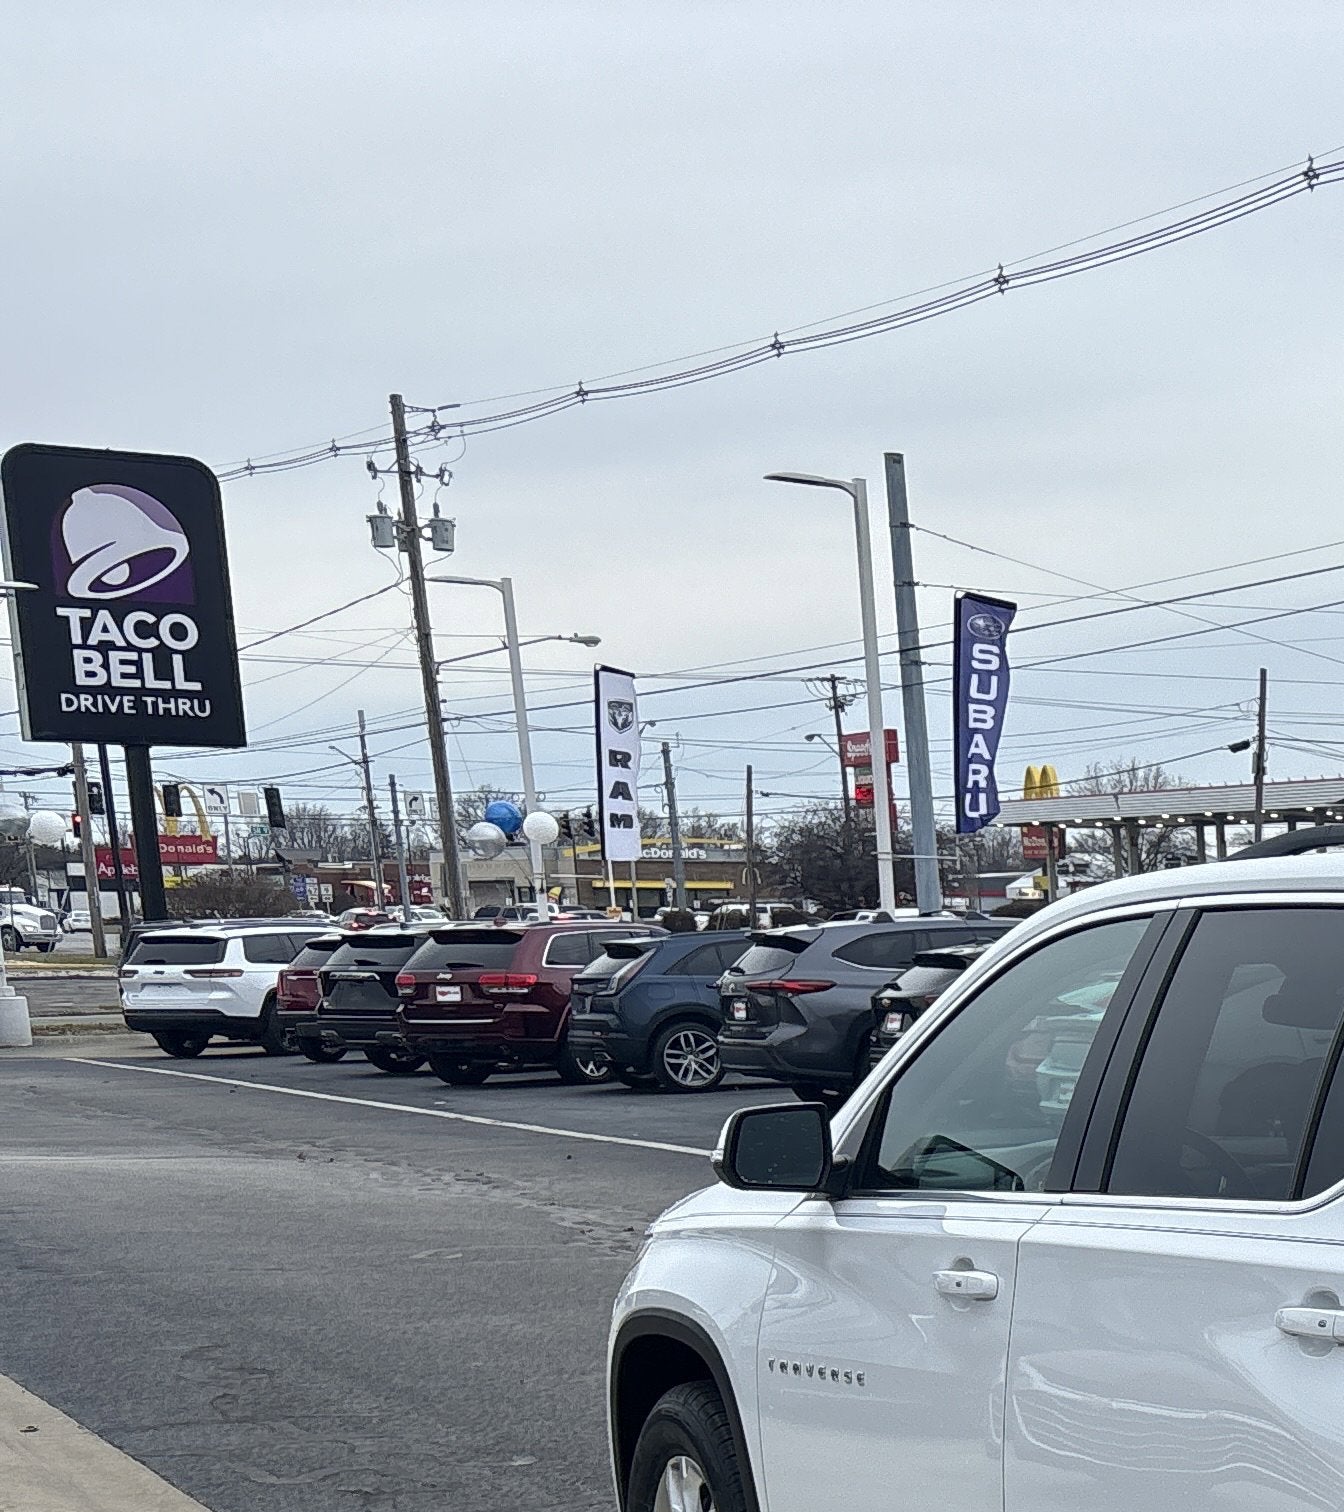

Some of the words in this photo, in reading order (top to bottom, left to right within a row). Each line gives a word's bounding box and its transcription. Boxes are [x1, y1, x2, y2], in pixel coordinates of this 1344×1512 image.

[56, 607, 199, 650] TACO
[72, 648, 202, 691] BELL
[60, 692, 137, 714] DRIVE
[141, 696, 211, 718] THRU
[965, 643, 1000, 818] SUBARU
[608, 749, 633, 829] RAM
[159, 843, 214, 854] Donald's
[767, 1356, 865, 1387] TRAVERSE
